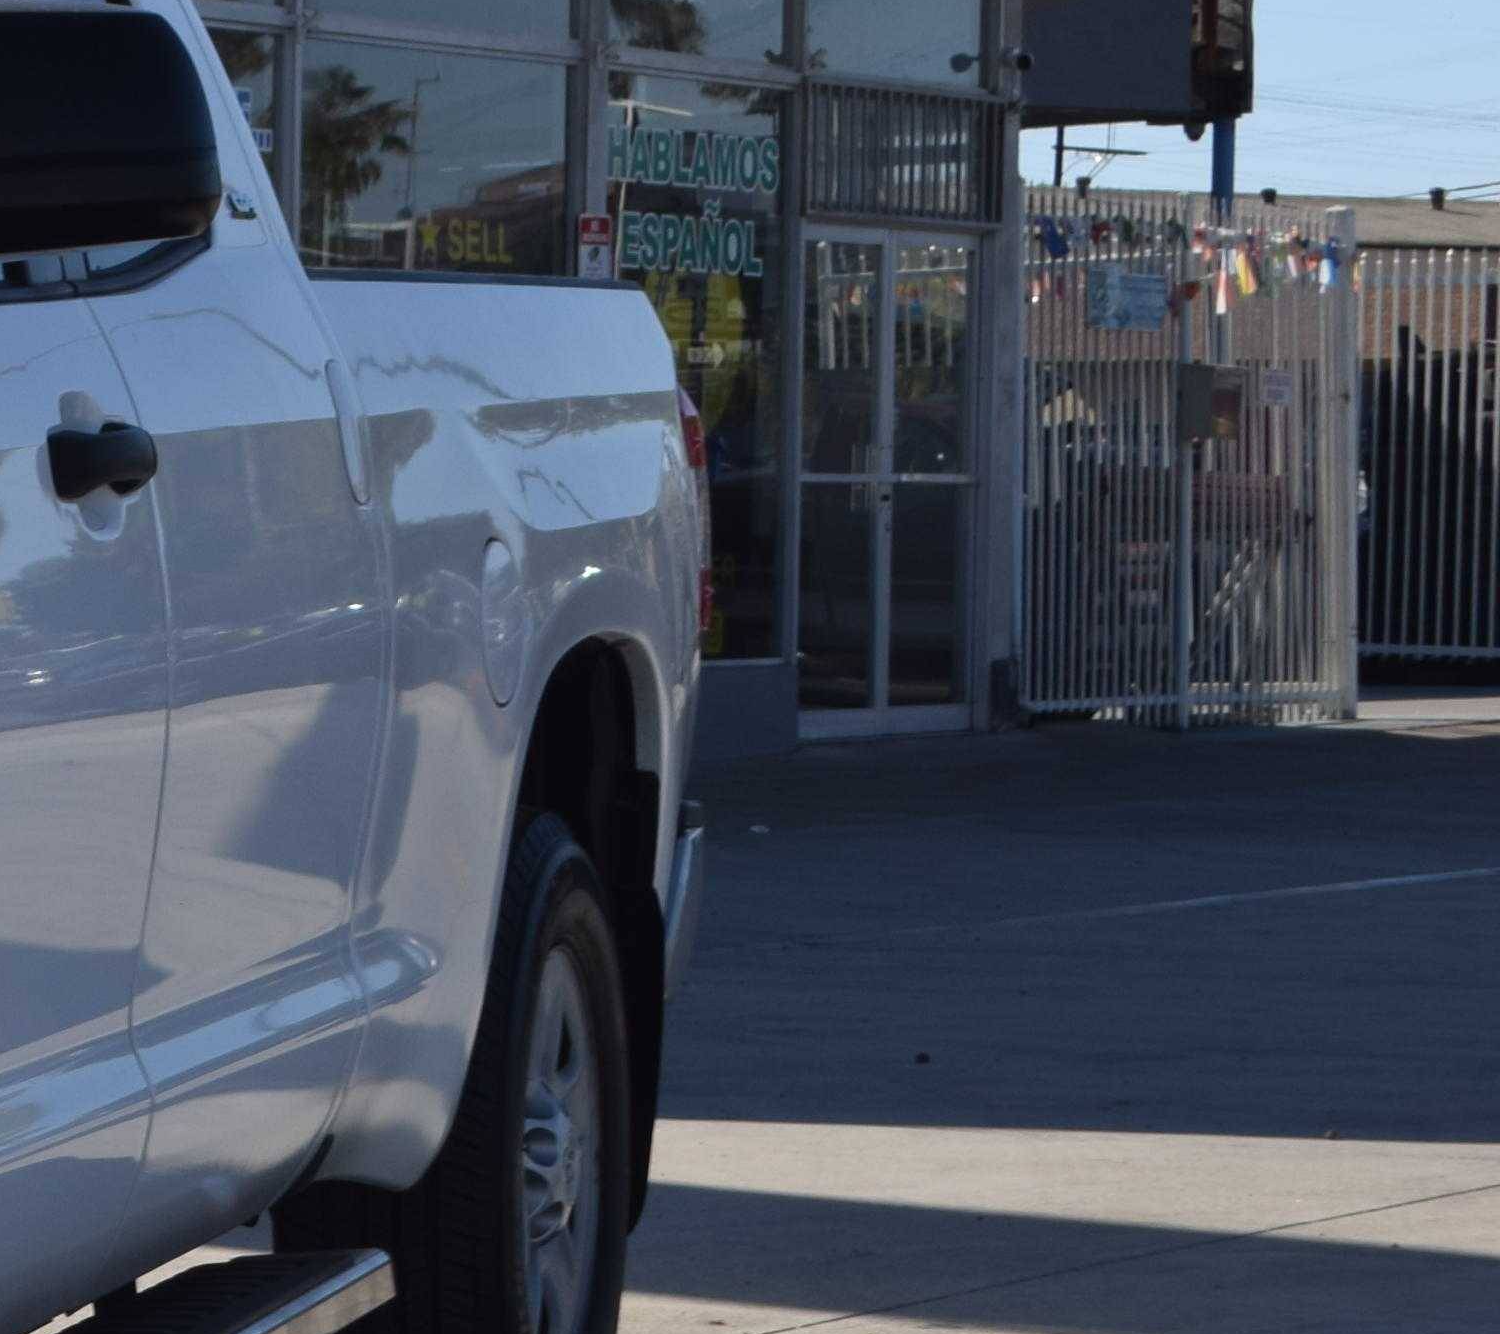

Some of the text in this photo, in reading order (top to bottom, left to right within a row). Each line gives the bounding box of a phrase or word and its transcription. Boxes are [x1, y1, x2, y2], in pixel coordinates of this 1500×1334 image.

[606, 124, 780, 194] HABLAMOS
[446, 219, 513, 265] SELL
[618, 197, 764, 278] ESPAÑOL
